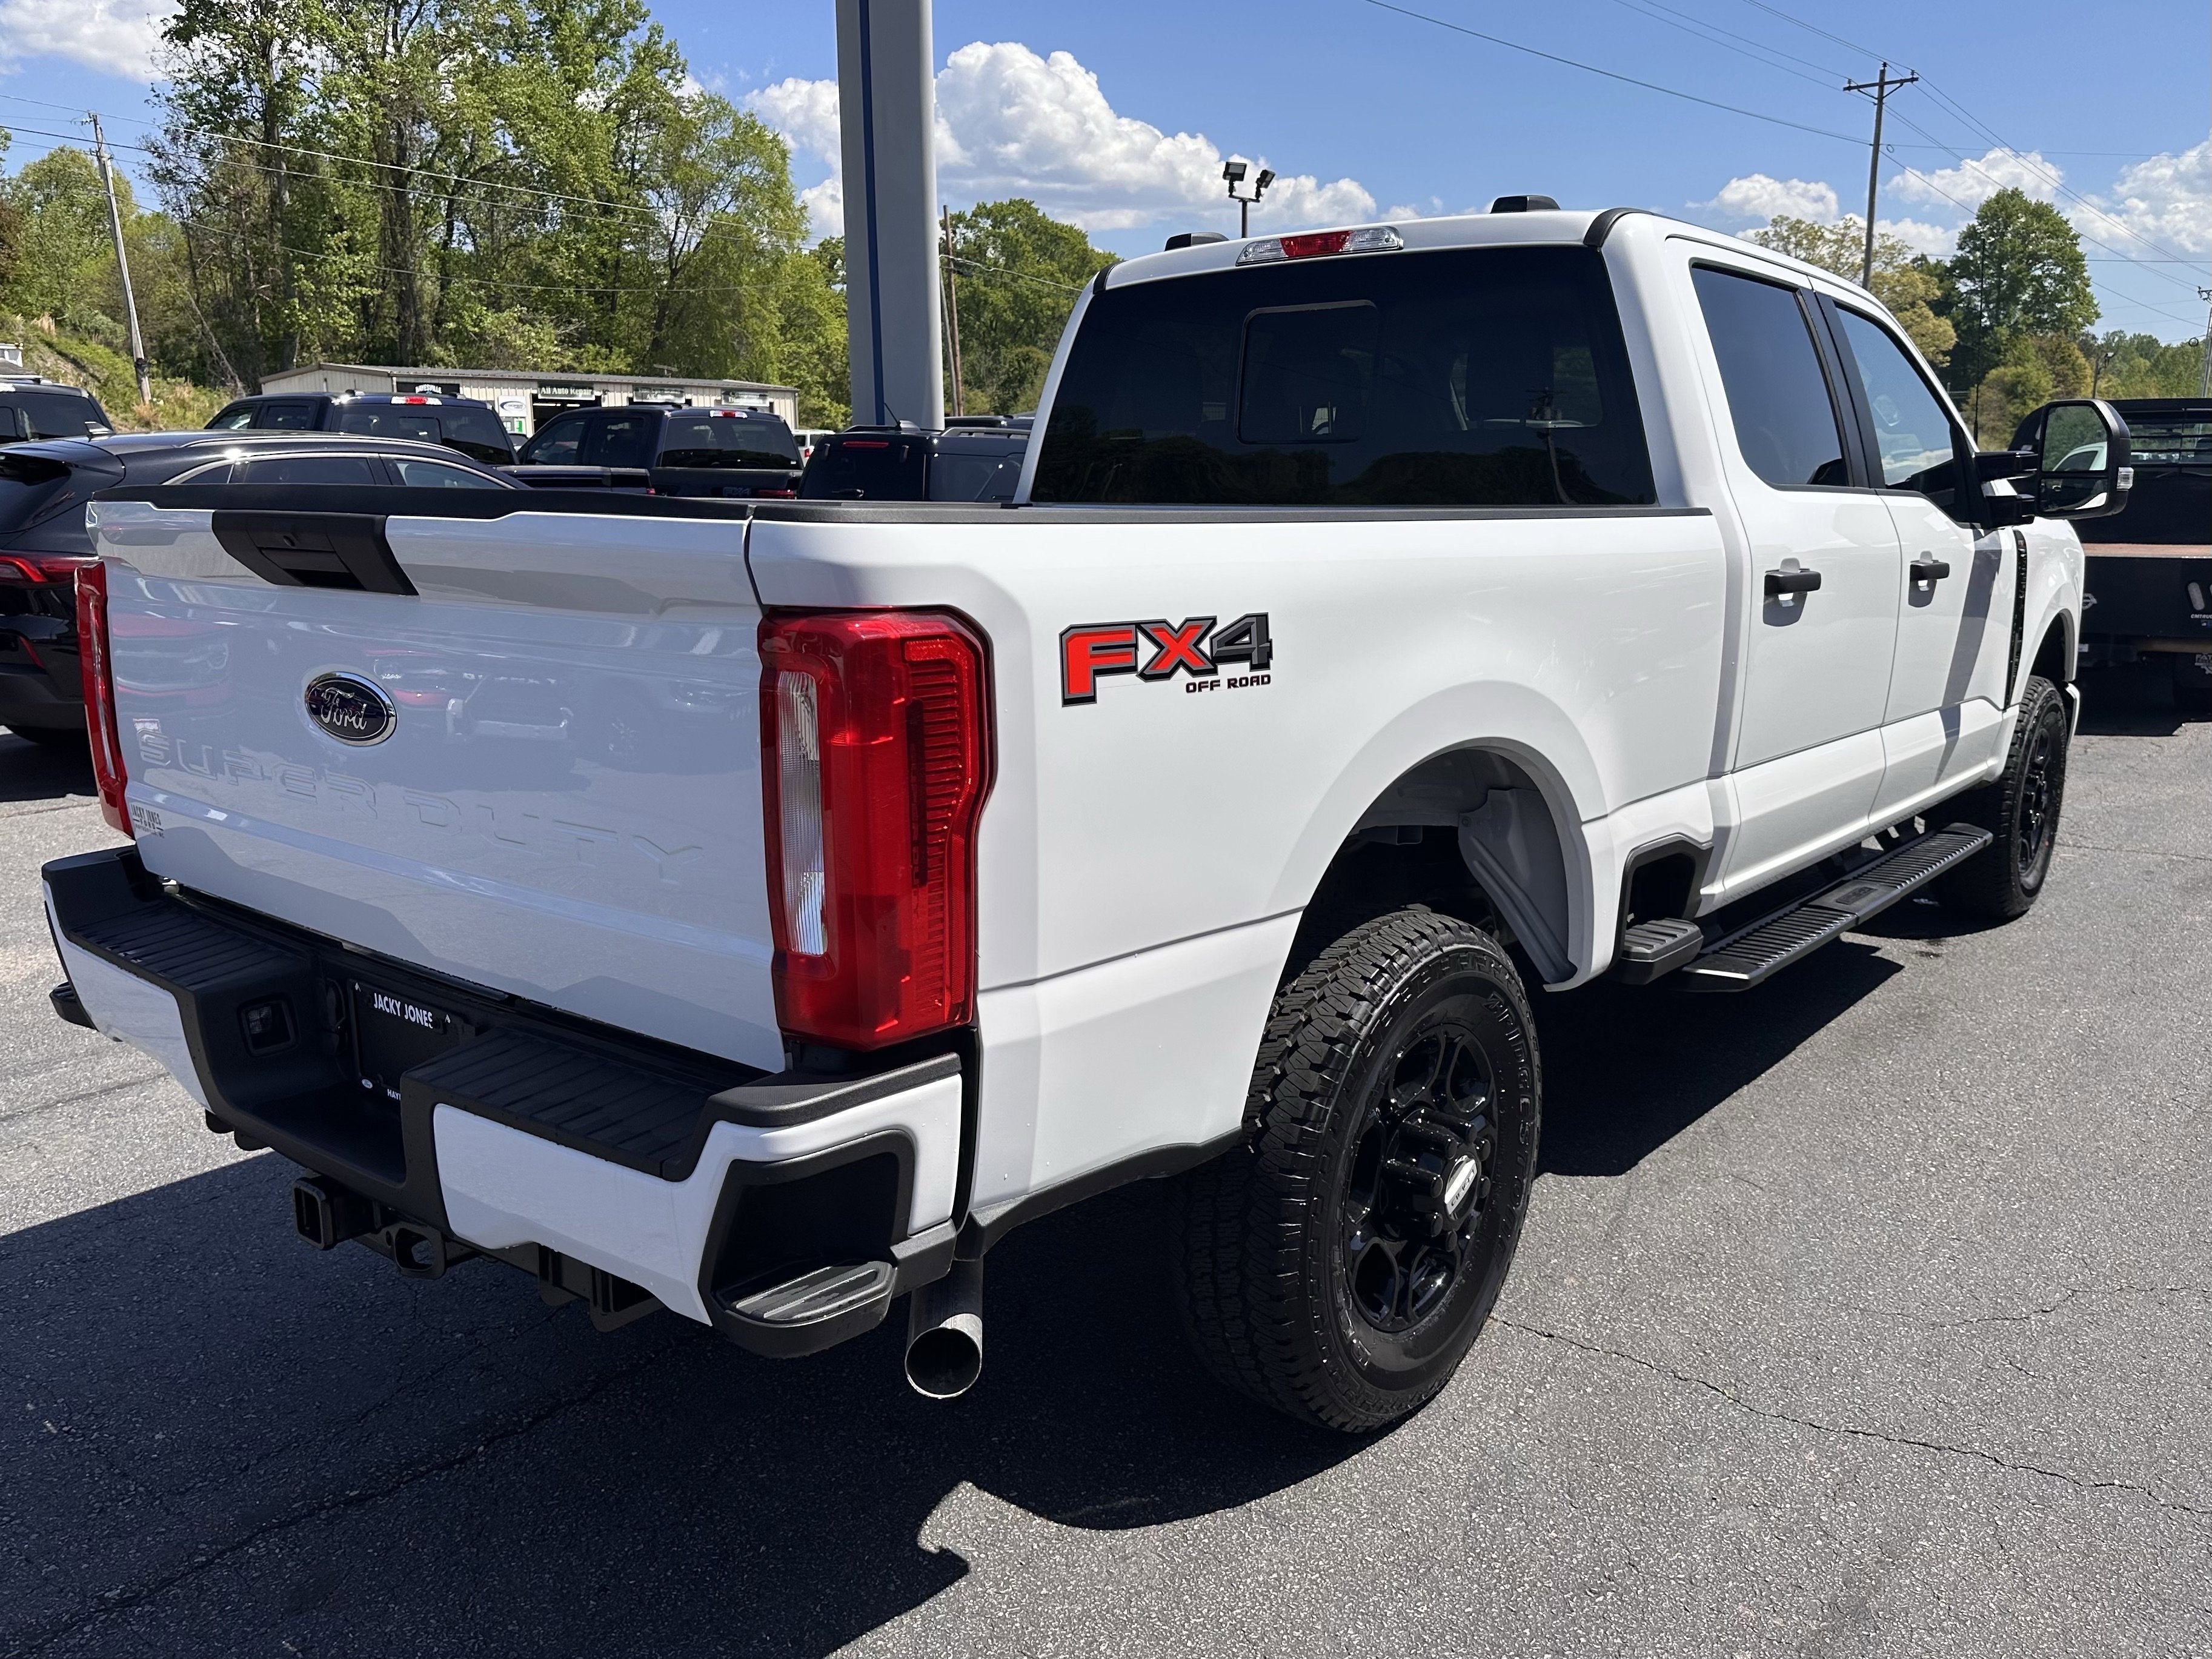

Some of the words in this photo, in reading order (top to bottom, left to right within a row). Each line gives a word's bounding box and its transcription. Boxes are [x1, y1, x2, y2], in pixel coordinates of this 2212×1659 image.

[540, 386, 551, 394] All
[570, 388, 593, 397] Repair
[1058, 612, 1273, 708] FX4
[1185, 679, 1221, 694] OFF
[1227, 674, 1271, 690] ROAD
[321, 687, 368, 730] Ford
[138, 728, 377, 818] SUPER
[402, 789, 703, 885] DUTY
[373, 992, 400, 1017] JACKY
[404, 1003, 434, 1029] JONES
[387, 1088, 401, 1101] HAY
